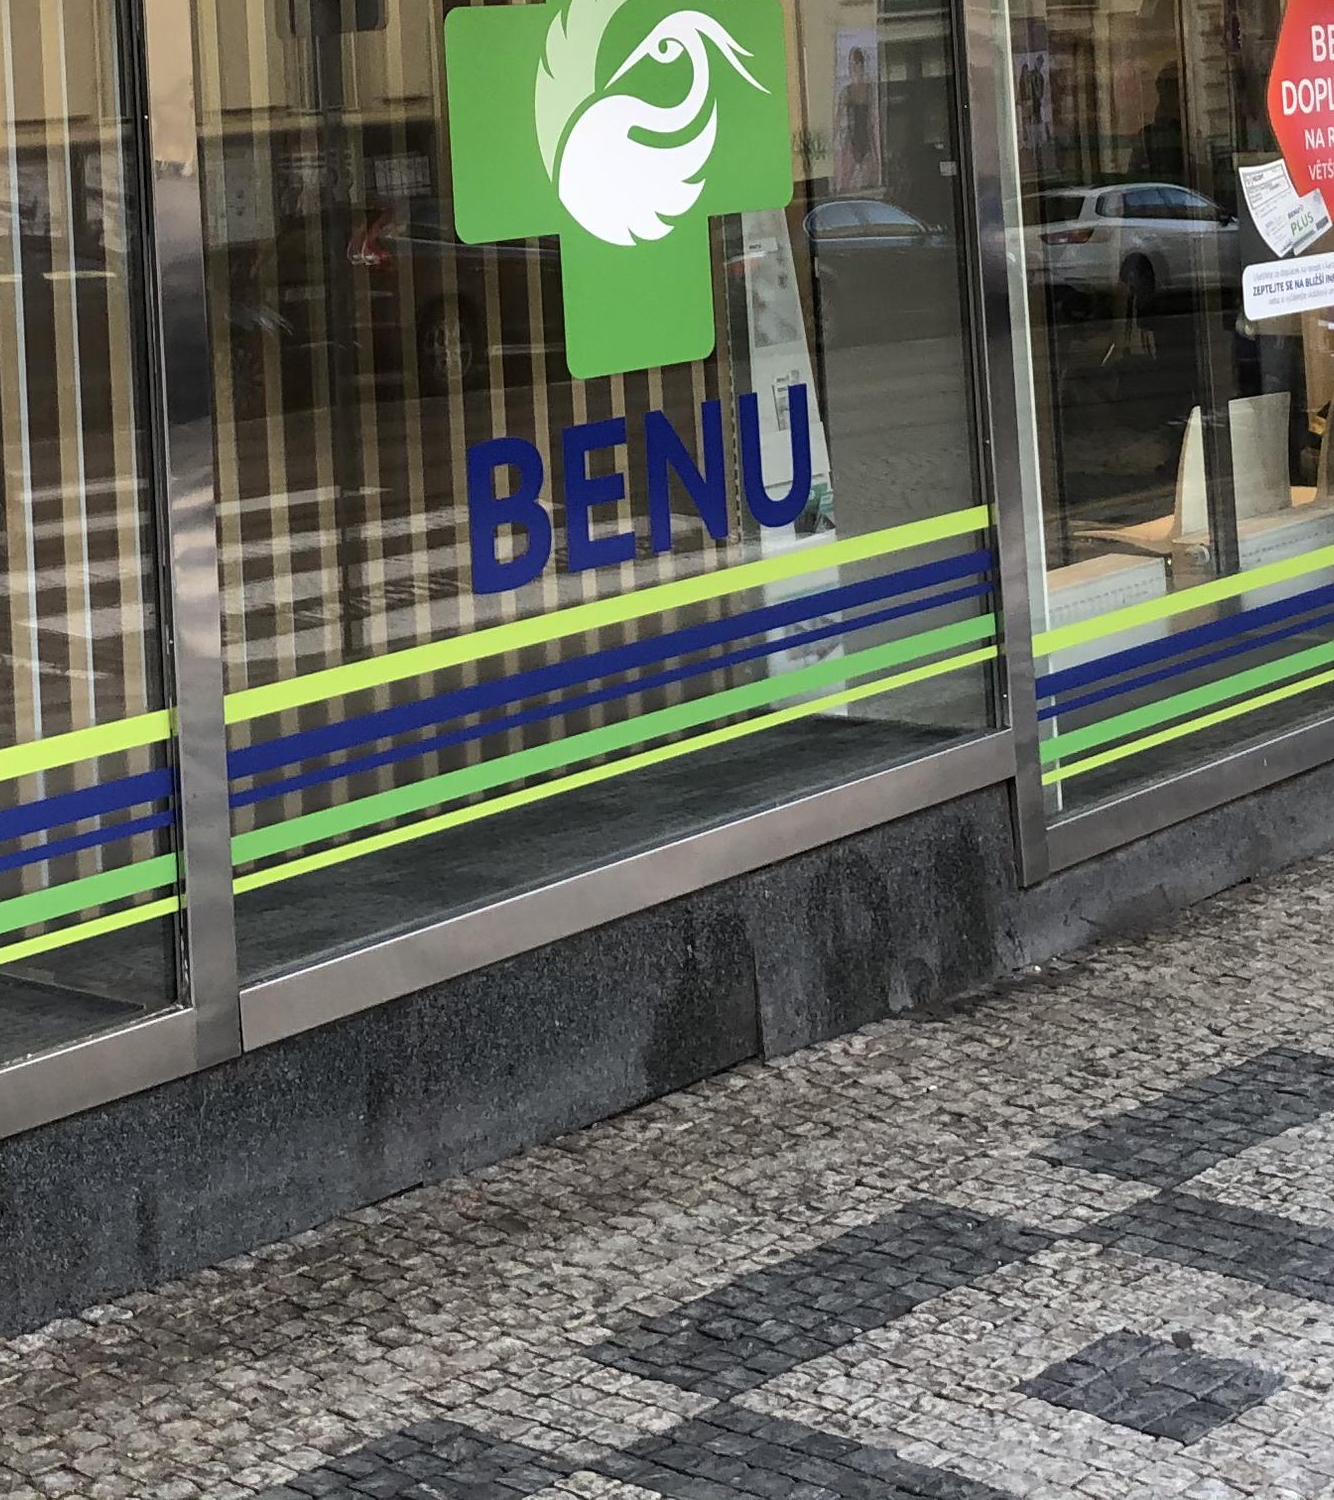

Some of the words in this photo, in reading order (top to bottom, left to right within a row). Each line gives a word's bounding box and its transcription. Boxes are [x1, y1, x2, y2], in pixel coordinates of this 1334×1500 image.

[1304, 129, 1325, 149] NA
[1290, 211, 1314, 236] PLUS
[1253, 282, 1284, 296] ZEPTEJTE
[1285, 280, 1293, 291] SE
[1295, 278, 1304, 288] NA
[468, 383, 814, 595] BENU
